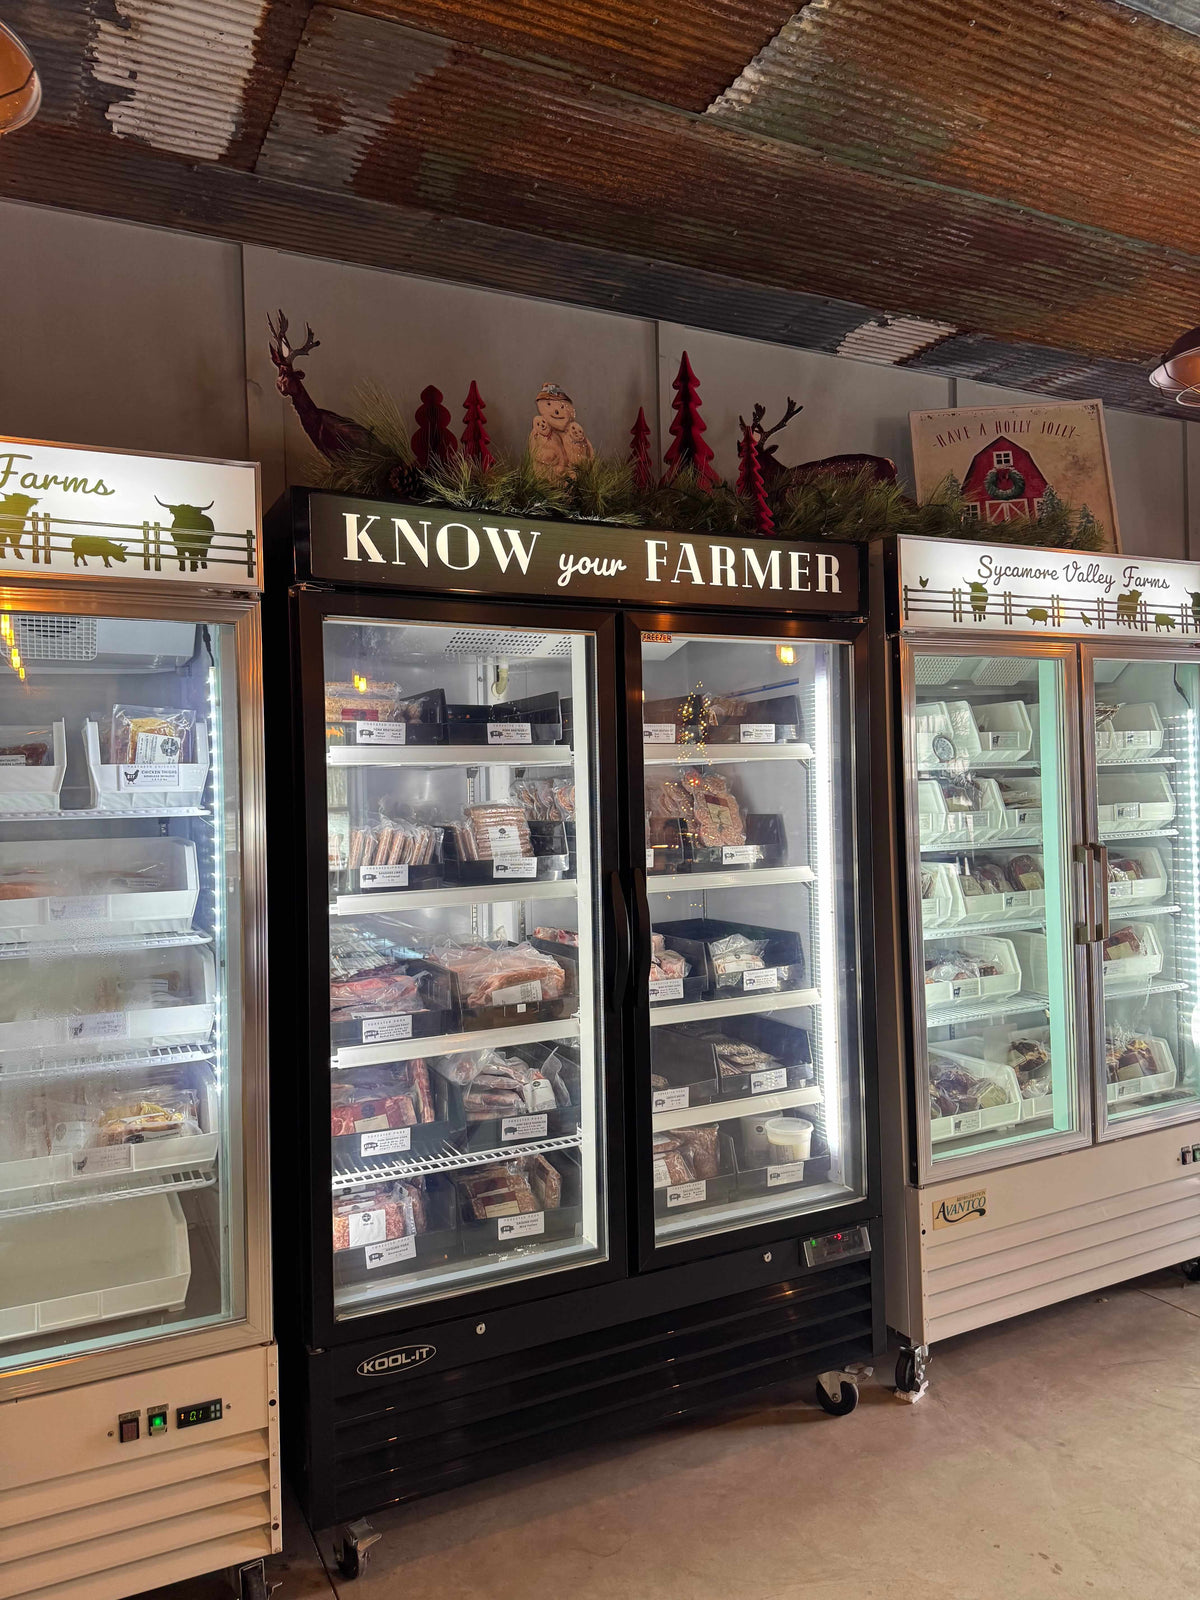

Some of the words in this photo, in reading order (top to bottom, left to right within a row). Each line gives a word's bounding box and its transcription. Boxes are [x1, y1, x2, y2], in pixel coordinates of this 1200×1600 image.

[980, 423, 987, 435] A
[995, 420, 1031, 434] HOLLY
[0, 453, 115, 495] Farms
[343, 513, 541, 574] KNOW
[557, 553, 627, 587] your
[644, 539, 841, 594] FARMER
[977, 554, 1059, 586] Sycamore
[1062, 561, 1116, 594] Valley
[1122, 565, 1170, 590] Farms
[643, 632, 672, 642] FREEZER
[935, 1196, 986, 1222] AVANTCO
[363, 1347, 430, 1374] KOOL-IT
